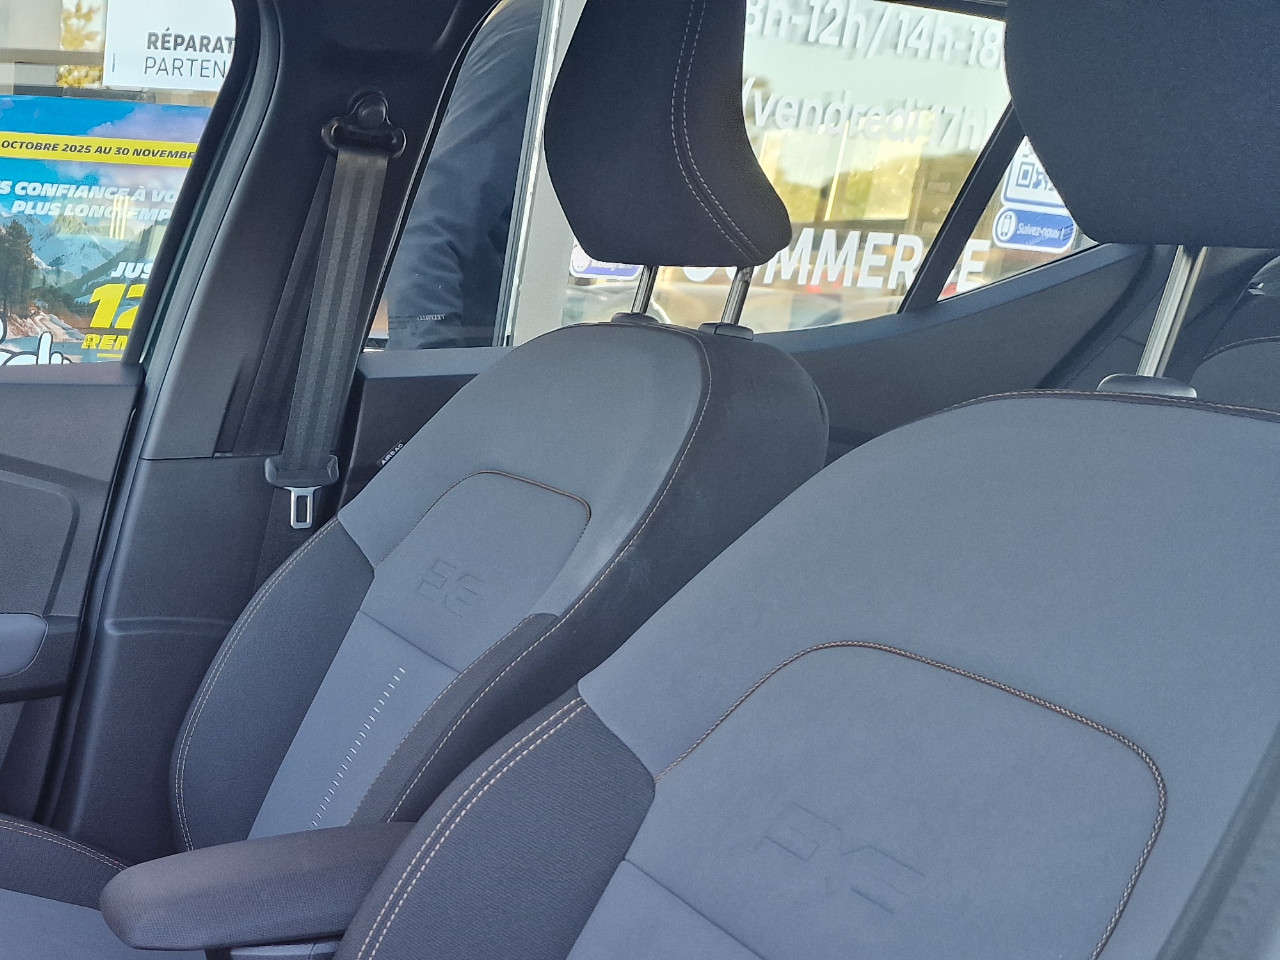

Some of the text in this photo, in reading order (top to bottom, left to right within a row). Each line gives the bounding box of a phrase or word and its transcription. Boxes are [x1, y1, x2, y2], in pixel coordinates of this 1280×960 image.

[146, 26, 235, 54] RÉPARAT
[143, 56, 226, 79] PARTEN
[1, 140, 60, 152] OCTOBRE
[61, 143, 93, 154] 2025
[94, 145, 112, 155] AU
[113, 146, 130, 156] 30
[14, 181, 131, 201] CONFIANCE
[130, 185, 146, 202] À
[11, 200, 172, 223] PLUS LONGEMP
[683, 228, 992, 292] MMERE
